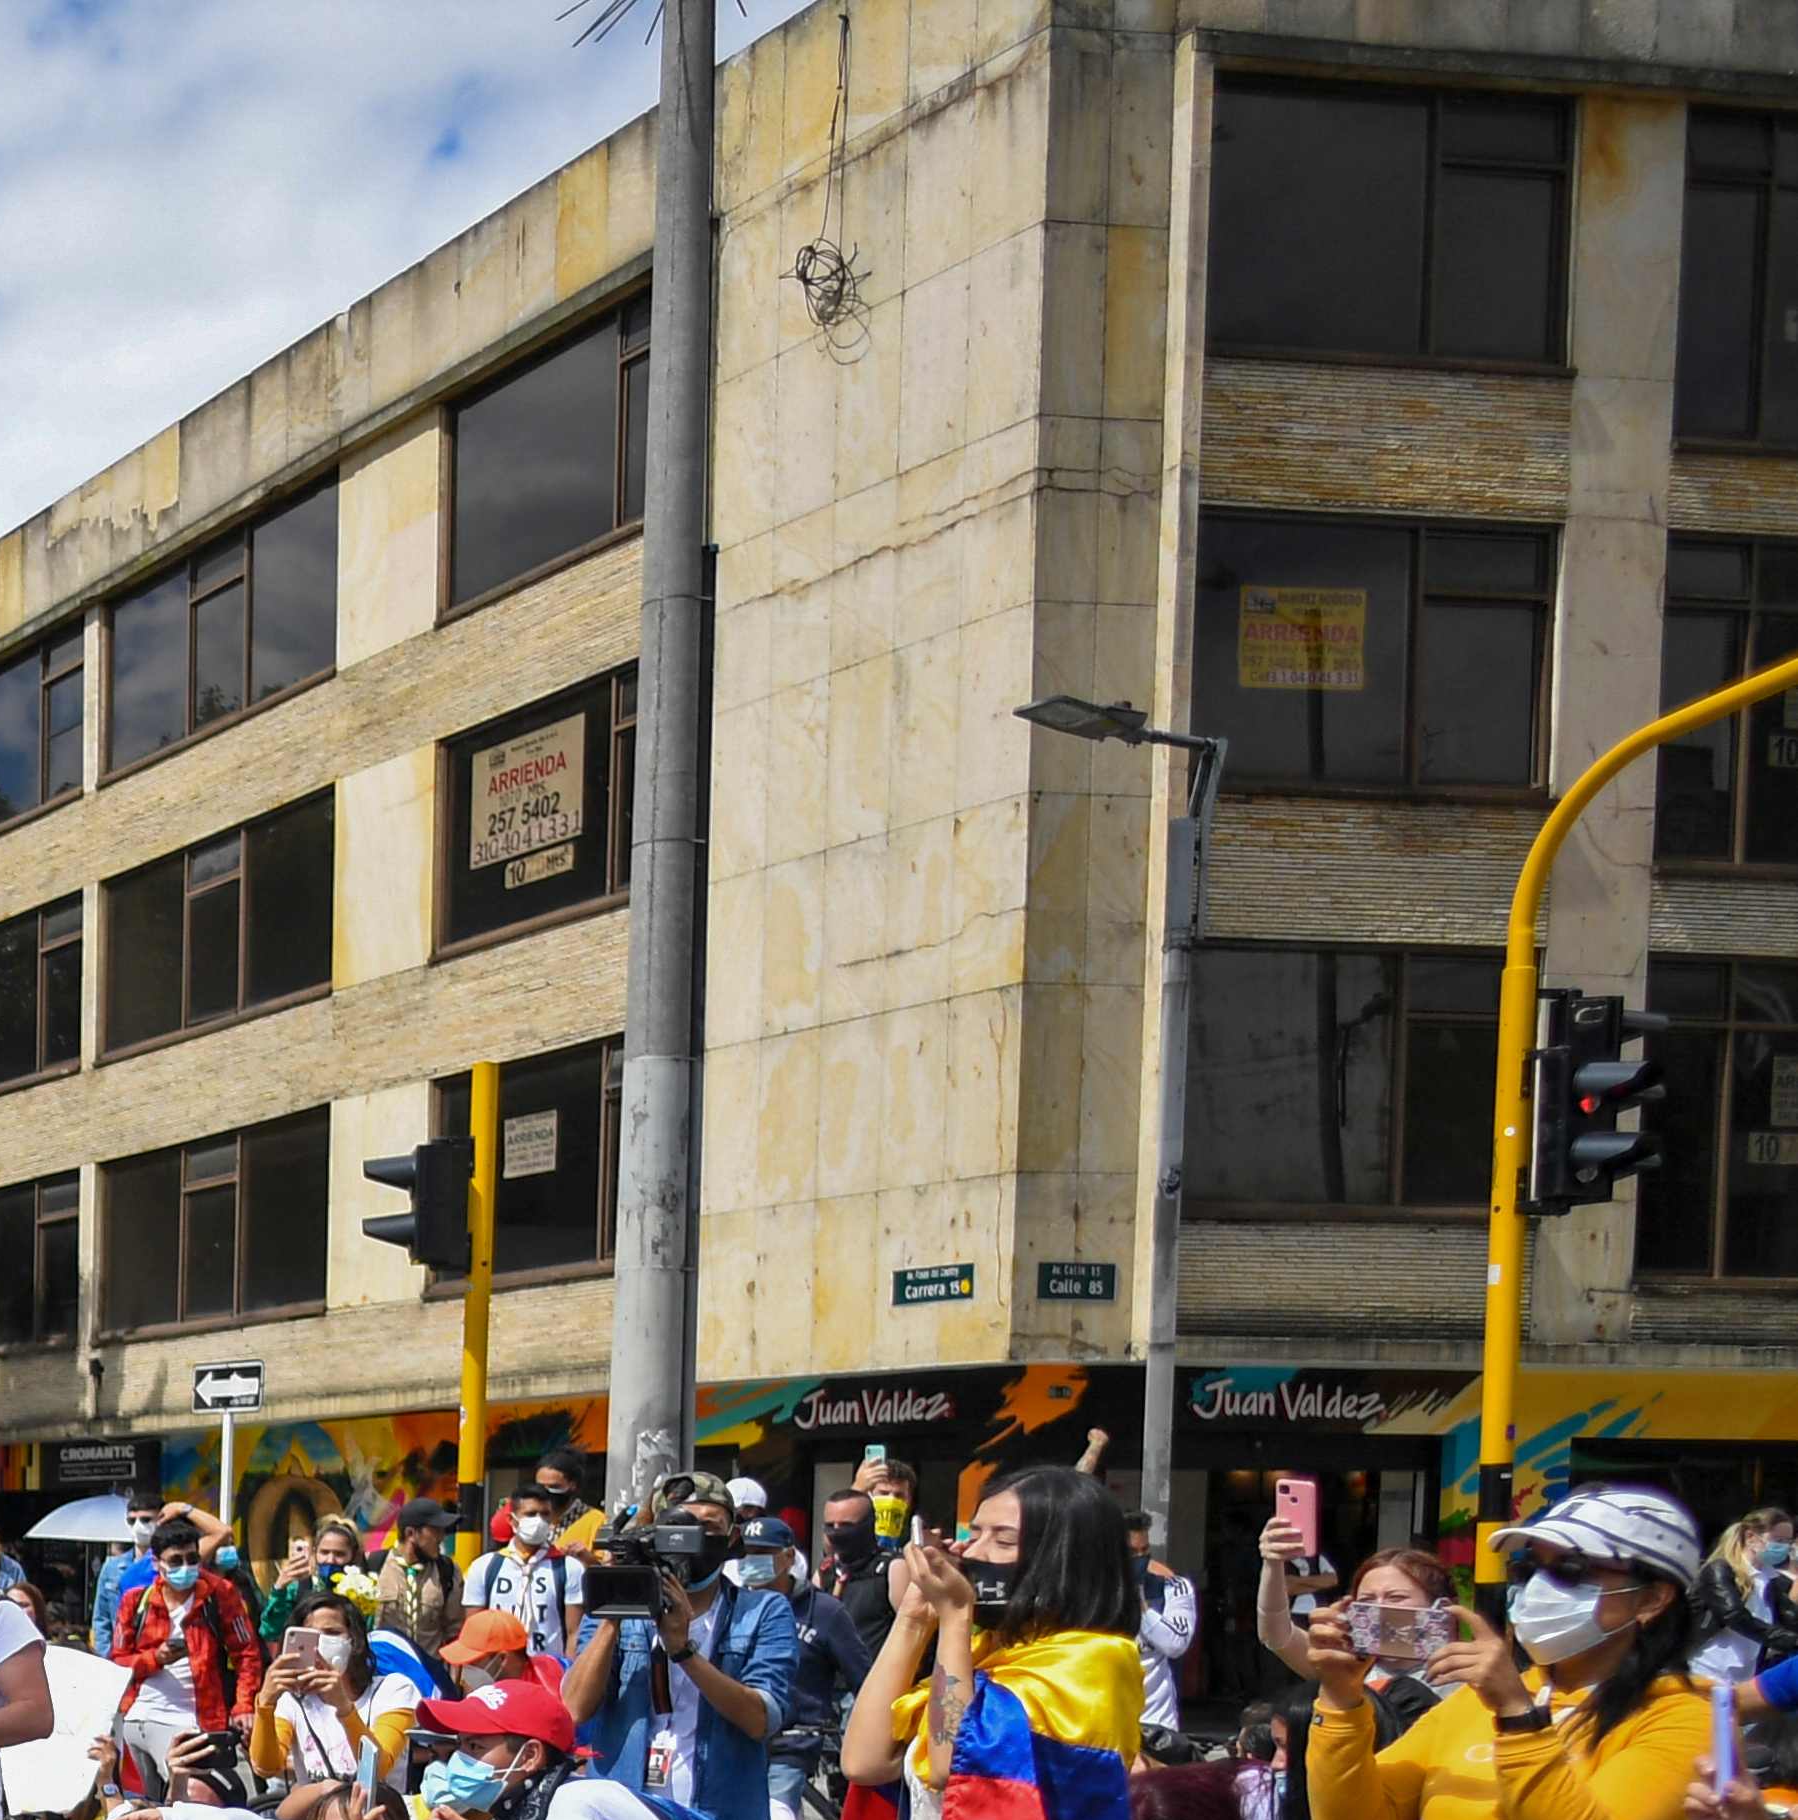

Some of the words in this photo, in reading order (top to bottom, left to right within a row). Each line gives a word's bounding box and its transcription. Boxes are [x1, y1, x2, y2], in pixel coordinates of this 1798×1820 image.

[1245, 623, 1358, 642] ARRIENDA
[487, 751, 568, 797] ARRIENDA
[488, 806, 517, 837] 257
[521, 790, 560, 826] 5402
[510, 861, 527, 886] 10
[905, 1283, 946, 1300] Carrera
[1049, 1279, 1082, 1295] Calle
[1088, 1280, 1103, 1296] 85
[794, 1388, 860, 1431] Juan
[861, 1388, 951, 1427] Valdez
[1192, 1378, 1276, 1420] Juan
[1279, 1382, 1387, 1422] Valdez
[60, 1445, 135, 1462] CROMANTIC
